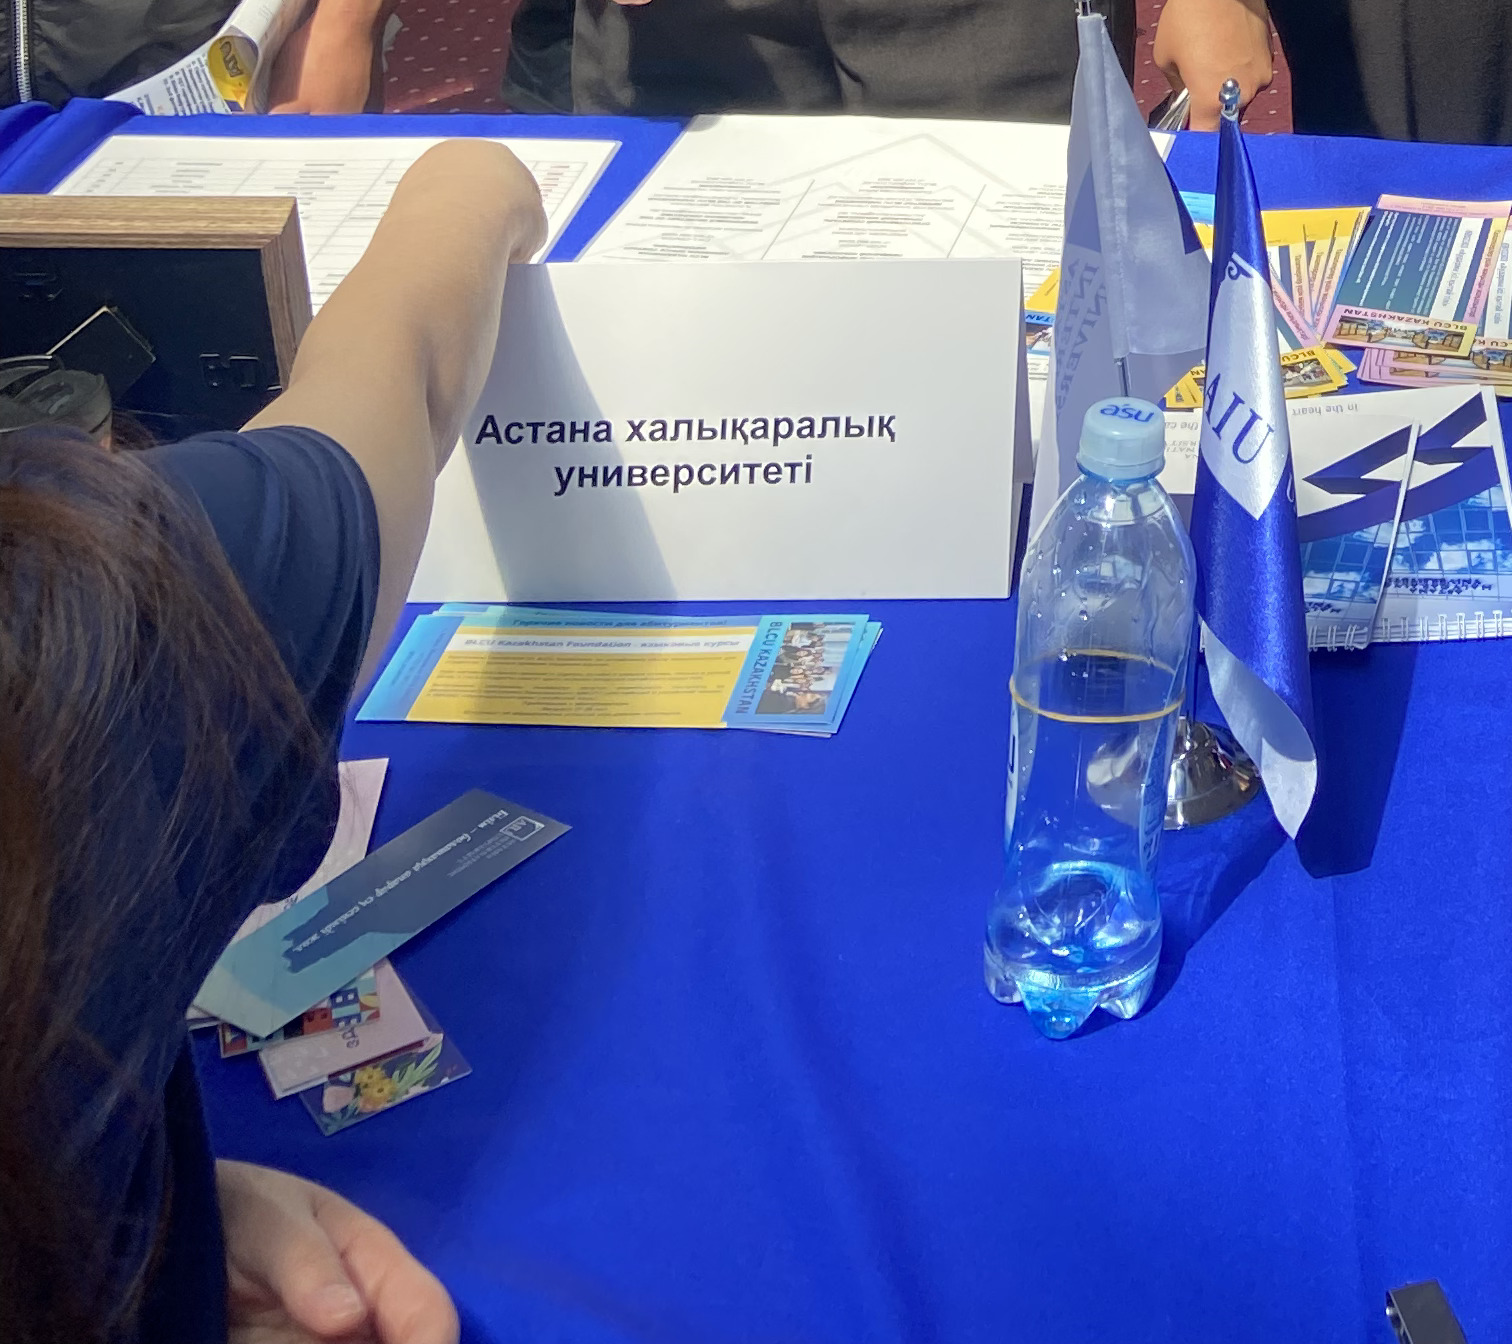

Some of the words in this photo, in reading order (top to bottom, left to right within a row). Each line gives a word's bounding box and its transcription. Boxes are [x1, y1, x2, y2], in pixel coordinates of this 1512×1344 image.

[1432, 319, 1468, 332] BLCU
[1291, 406, 1322, 418] heart
[1325, 404, 1344, 417] the
[1347, 402, 1359, 413] in
[1204, 373, 1275, 464] AIU
[475, 414, 612, 445] Астана
[625, 414, 897, 448] халықаралық
[553, 454, 814, 497] университеті
[497, 639, 564, 648] Kazakhstan
[565, 640, 632, 648] Foundation
[762, 621, 784, 649] BLCU
[734, 648, 774, 715] KAZAKHSTAN
